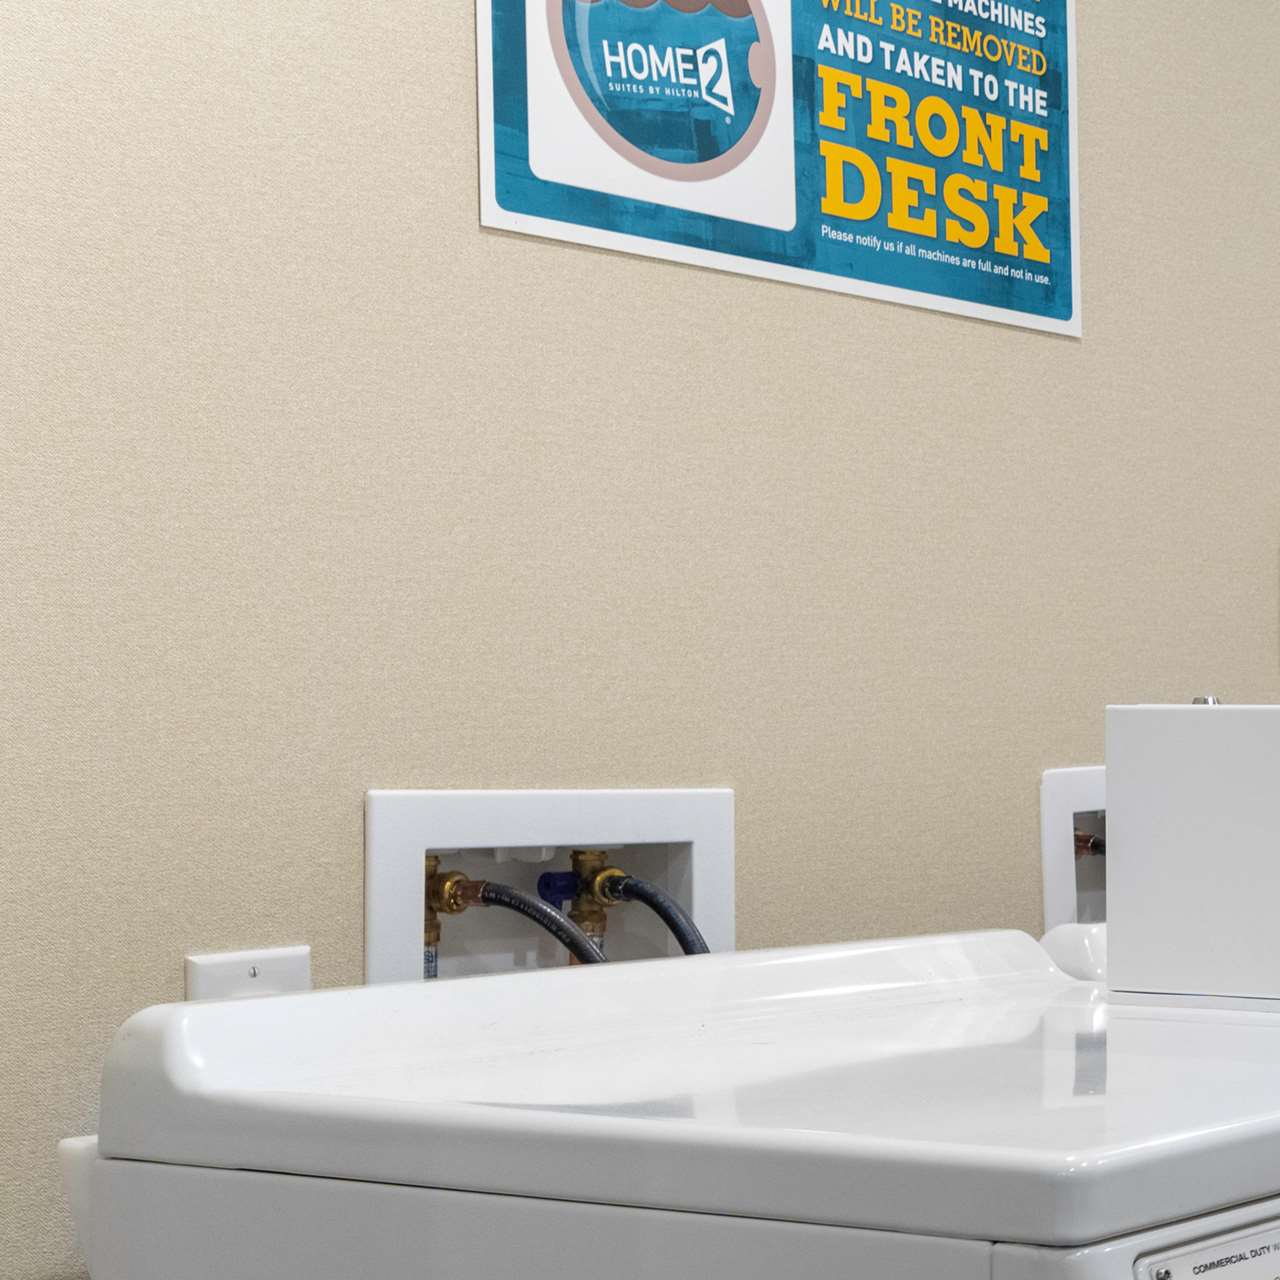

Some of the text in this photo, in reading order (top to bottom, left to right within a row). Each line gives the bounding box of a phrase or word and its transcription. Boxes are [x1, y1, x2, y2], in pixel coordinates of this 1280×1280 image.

[817, 24, 1048, 117] AND TAKEN TO THE
[889, 3, 922, 38] BE
[928, 15, 1047, 76] REMOVED
[608, 82, 699, 98] SUITES BY HILTON
[817, 64, 1048, 182] FRONT
[819, 139, 1050, 263] DESK
[821, 224, 1051, 286] Please notify us if all machines are full and not in use.
[1192, 1252, 1249, 1275] COMMERCIAL
[1250, 1245, 1272, 1258] DUTY
